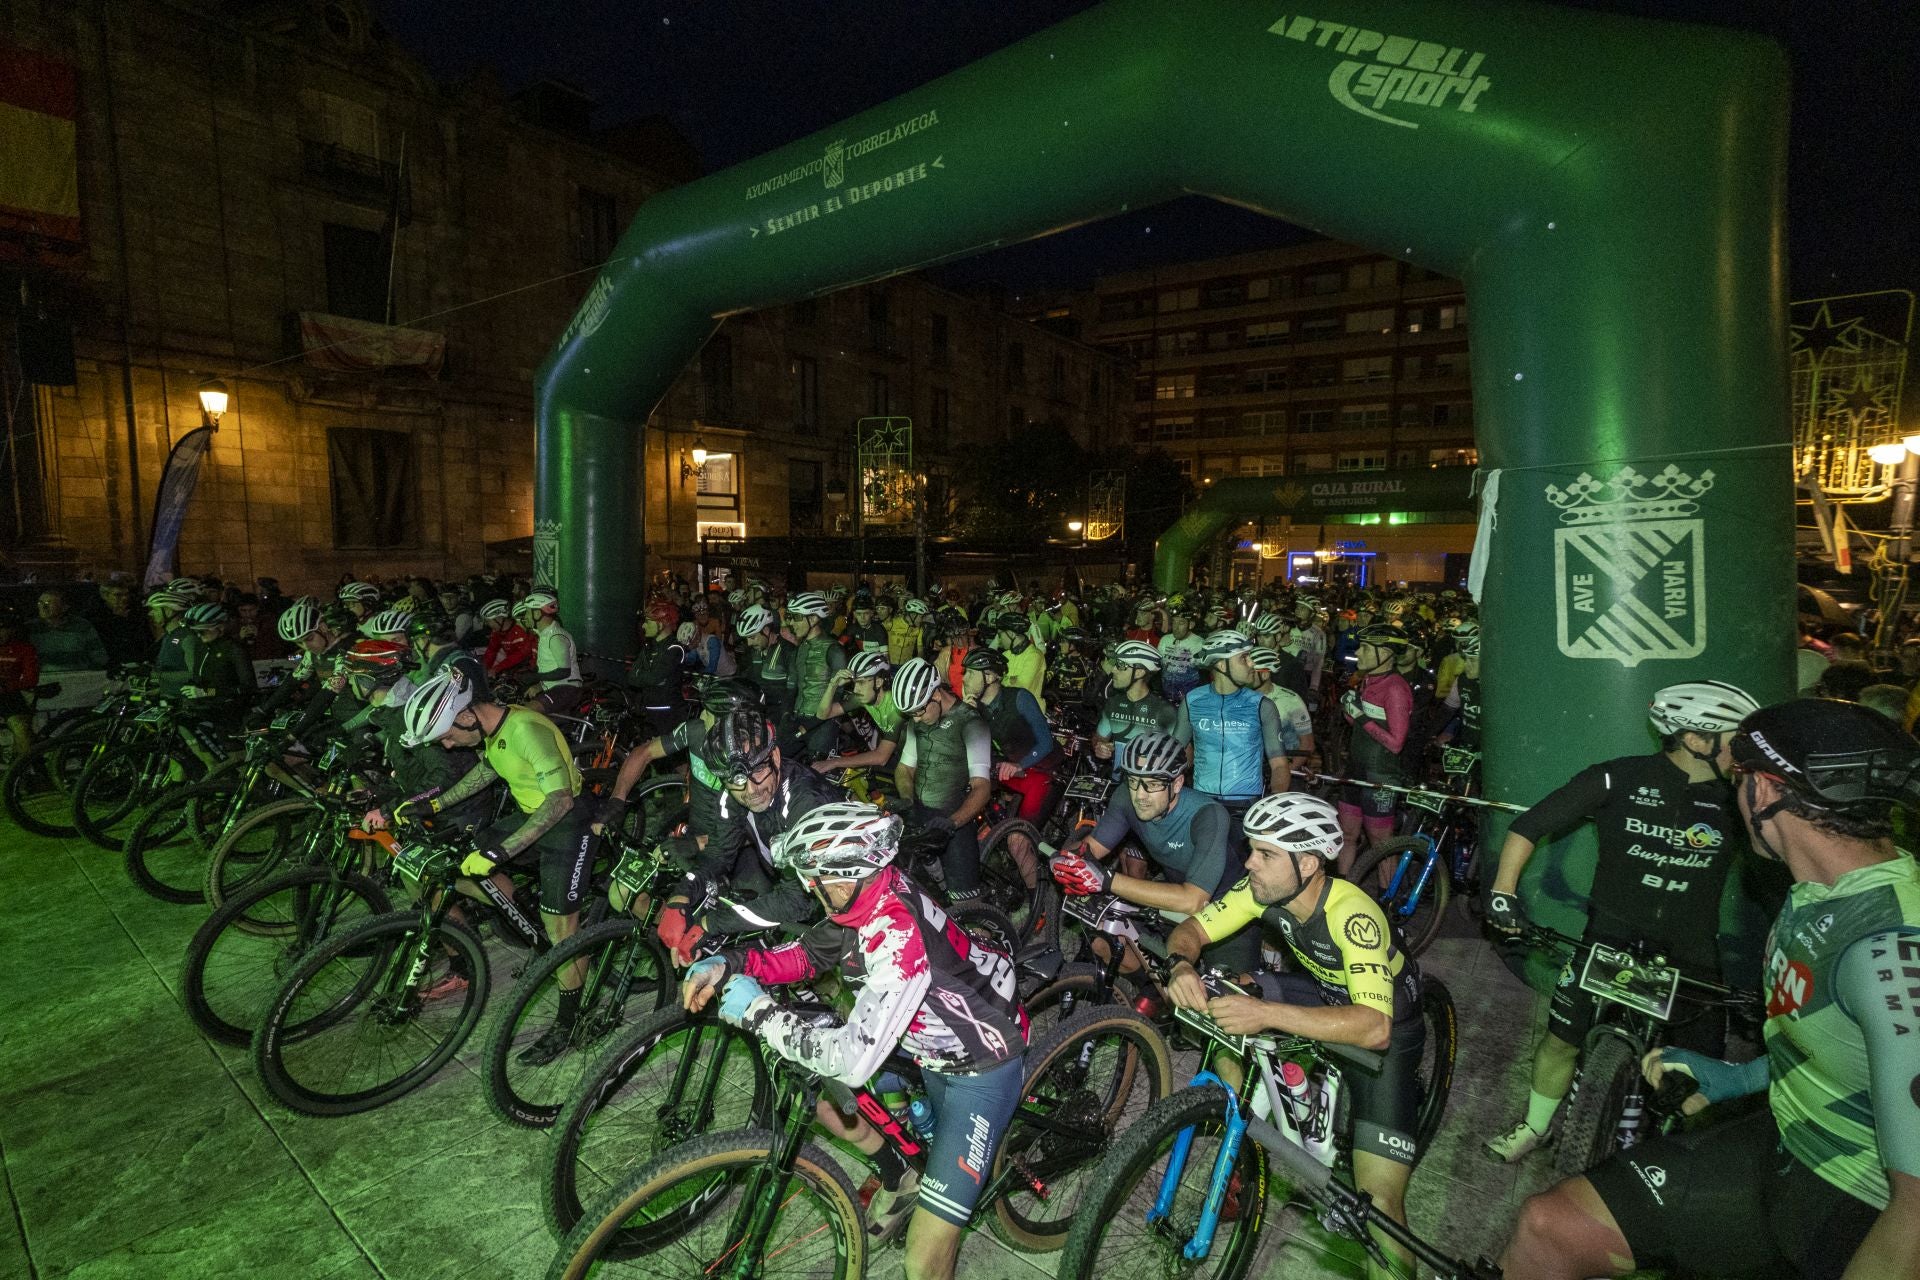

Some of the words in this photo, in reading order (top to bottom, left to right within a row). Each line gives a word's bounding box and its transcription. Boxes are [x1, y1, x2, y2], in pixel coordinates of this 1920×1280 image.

[1266, 15, 1486, 79] ARTIPUBLI
[1351, 63, 1492, 113] sport
[745, 158, 823, 200] AYUNTAMIENTO
[846, 110, 940, 160] TORRELAVEGA
[767, 204, 820, 236] SENTIR
[824, 196, 843, 214] EL
[846, 162, 928, 204] DEPORTE
[1312, 483, 1347, 496] CAJA
[1351, 480, 1406, 494] RURAL
[1573, 574, 1595, 613] AVE
[1663, 561, 1687, 619] MARIA
[1111, 712, 1156, 725] EQUILIBRIO
[1749, 730, 1803, 774] GIANT
[570, 835, 589, 889] DECATHLON
[1292, 838, 1327, 850] CANYON
[1640, 873, 1689, 893] BH
[479, 877, 538, 945] BERRIA
[1614, 969, 1634, 984] 6
[957, 1112, 990, 1185] Segafredo
